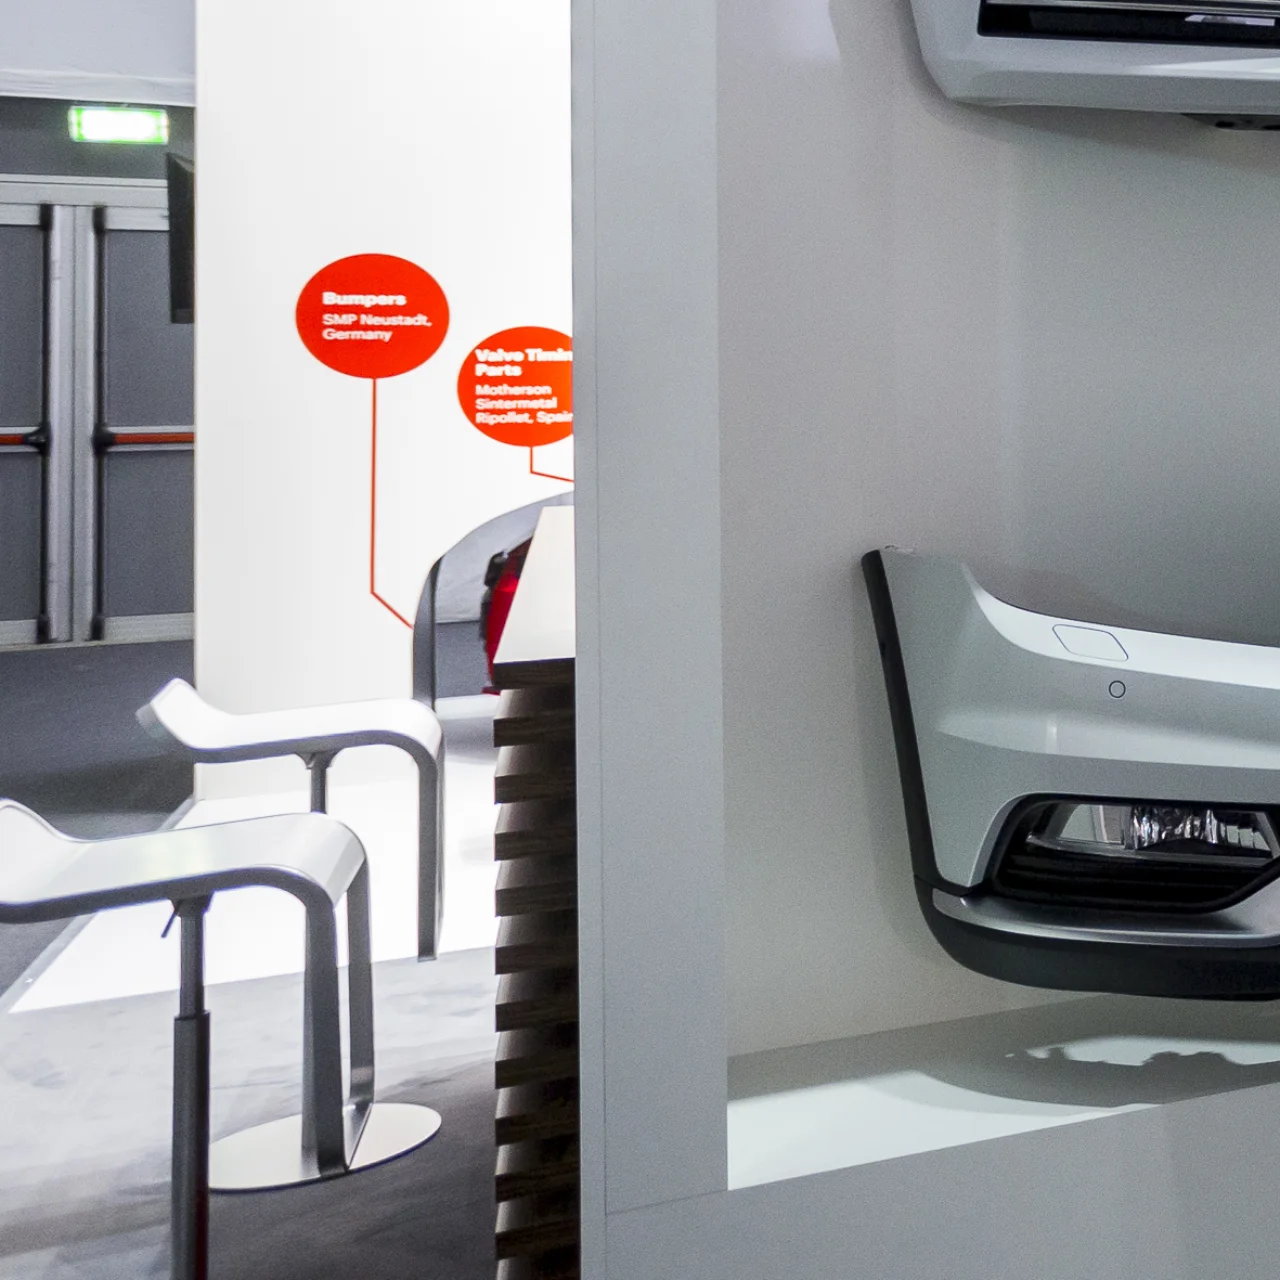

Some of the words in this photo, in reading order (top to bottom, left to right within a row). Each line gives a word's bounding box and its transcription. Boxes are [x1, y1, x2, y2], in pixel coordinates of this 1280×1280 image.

[322, 291, 407, 308] Bumpers
[322, 313, 358, 326] SMP
[322, 328, 393, 342] Germany
[475, 348, 525, 362] Valve
[475, 363, 523, 377] Parts
[475, 384, 553, 396] Motherson
[475, 396, 558, 410] Sintermetal
